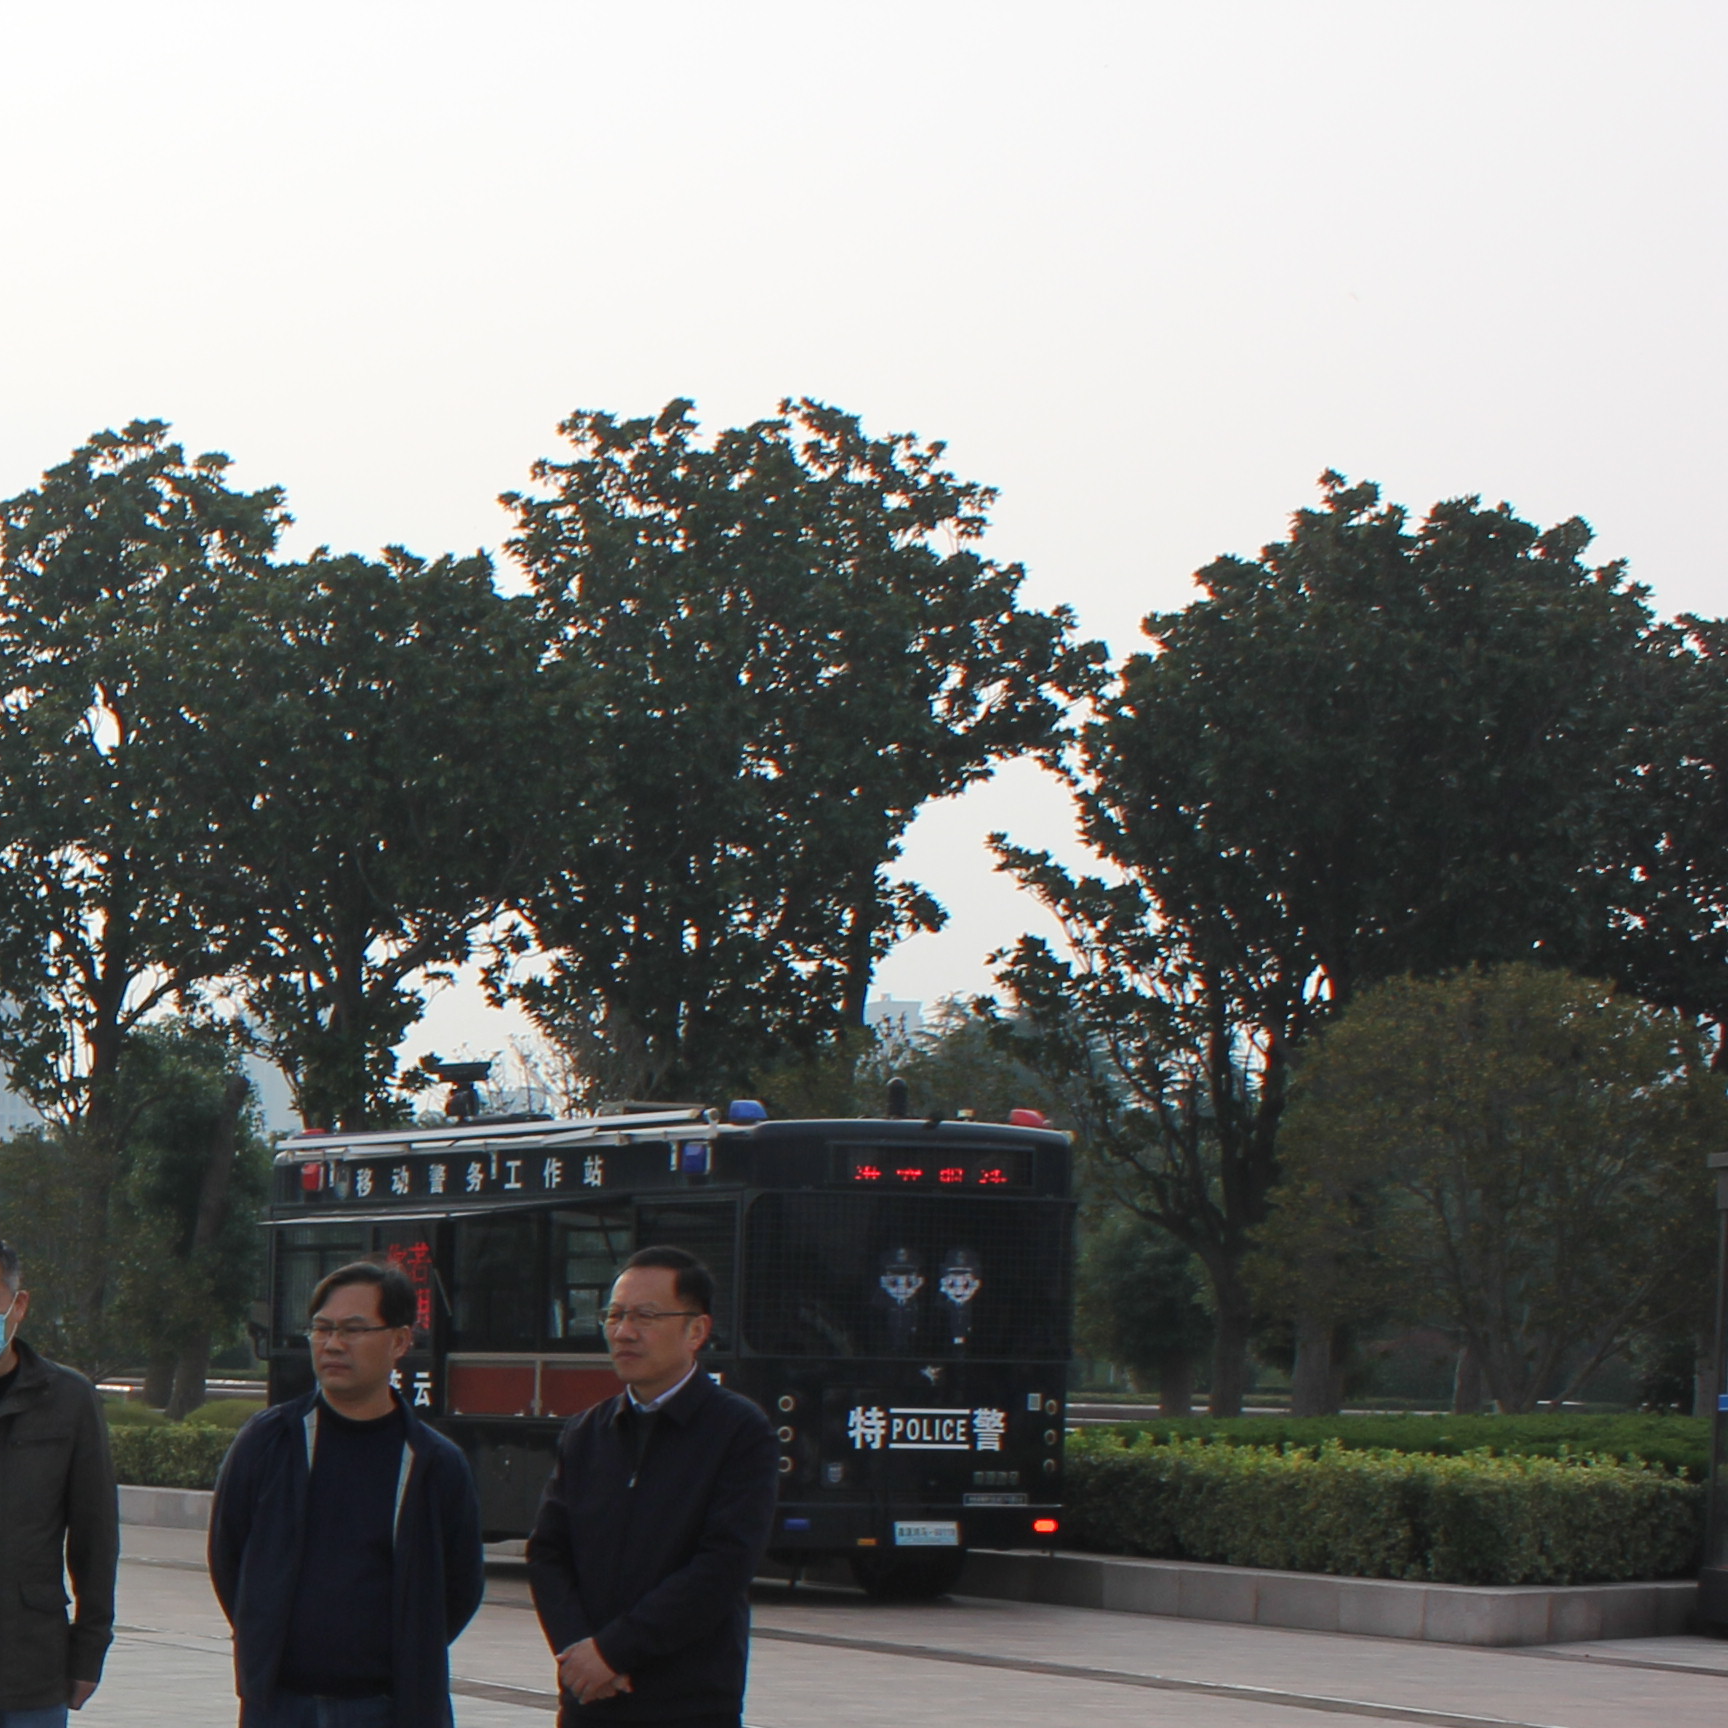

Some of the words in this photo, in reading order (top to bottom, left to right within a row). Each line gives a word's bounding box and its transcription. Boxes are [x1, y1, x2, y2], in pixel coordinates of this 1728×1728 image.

[355, 1154, 604, 1198] 移动警务工作站
[846, 1406, 887, 1450] 特
[891, 1418, 968, 1441] POLICE
[971, 1407, 1008, 1452] 警
